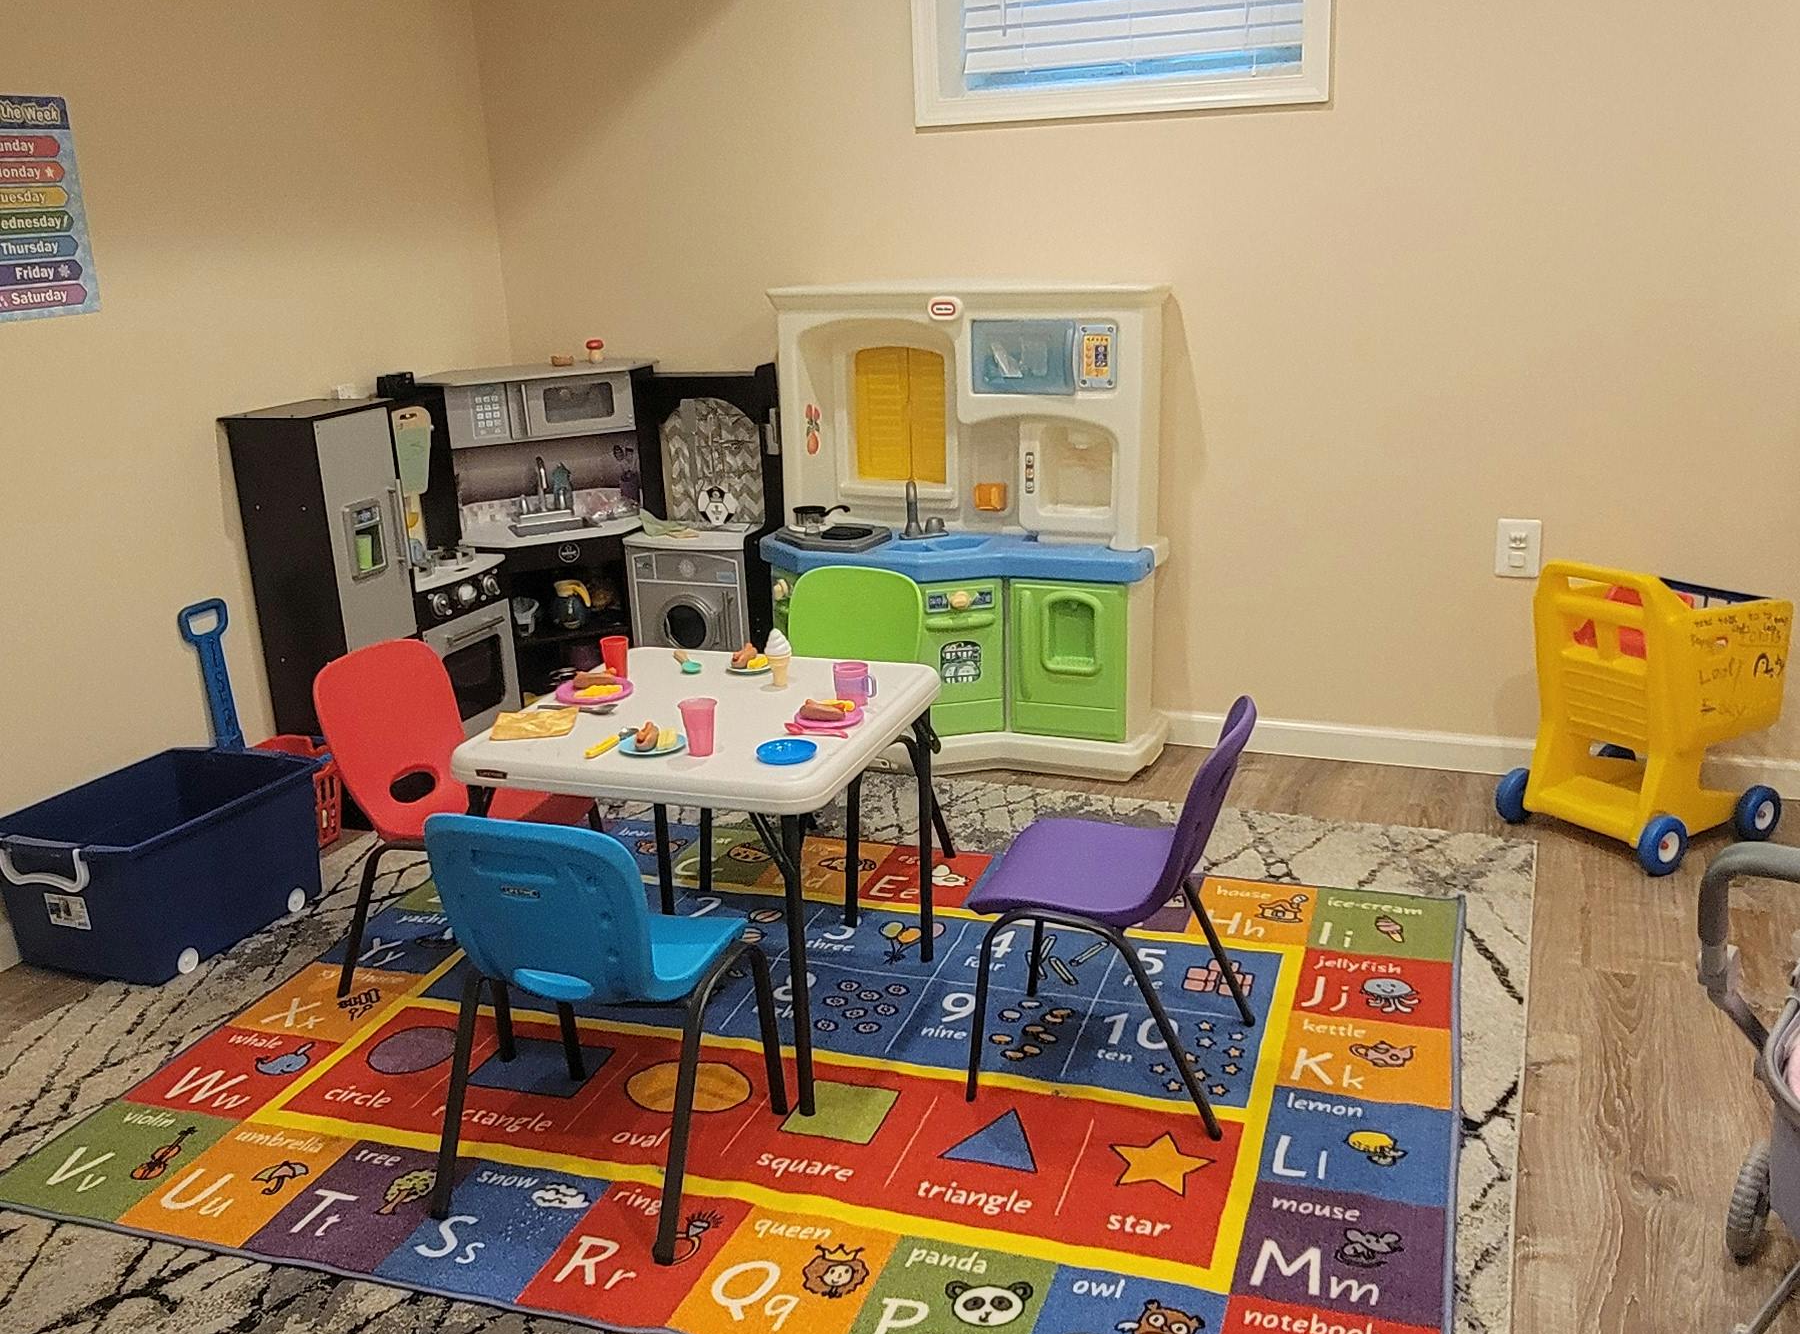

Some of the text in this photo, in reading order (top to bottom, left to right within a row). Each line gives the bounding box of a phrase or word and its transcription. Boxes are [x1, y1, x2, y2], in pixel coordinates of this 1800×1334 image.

[23, 103, 58, 121] Week
[0, 166, 40, 180] onday
[0, 190, 46, 204] uesday
[0, 215, 61, 229] ednesday
[1, 241, 58, 255] Thursday
[15, 265, 54, 280] Friday
[11, 289, 67, 305] Saturday
[869, 875, 919, 899] Ee
[1216, 885, 1272, 901] house
[1327, 896, 1424, 917] ice-cream
[396, 913, 449, 925] yacht
[805, 938, 856, 952] three
[976, 930, 1016, 958] 4
[1136, 948, 1168, 975] 5
[1313, 955, 1402, 975] jellyfish
[1301, 975, 1350, 1012] Jj
[259, 997, 325, 1030] Xx
[941, 991, 977, 1023] 9
[920, 1023, 968, 1041] nine
[1103, 1012, 1179, 1051] 10
[1302, 1018, 1367, 1039] kettle
[228, 1033, 284, 1049] whale
[1096, 1048, 1134, 1063] ten
[1289, 1047, 1366, 1090] Kk
[164, 1067, 250, 1111] Ww
[324, 1085, 393, 1109] circle
[1286, 1091, 1364, 1118] lemon
[121, 1110, 177, 1128] violin
[431, 1105, 553, 1134] rctangle
[234, 1128, 324, 1154] umbrella
[611, 1127, 672, 1149] oval
[45, 1146, 116, 1193] Vv
[354, 1148, 402, 1167] tree
[756, 1151, 856, 1183] square
[476, 1169, 540, 1189] snow
[160, 1168, 235, 1218] Uu
[612, 1188, 663, 1216] ring
[917, 1178, 1034, 1216] triangle
[289, 1188, 359, 1237] Tt
[1271, 1196, 1361, 1222] mouse
[753, 1217, 833, 1241] queen
[1106, 1213, 1173, 1238] star
[414, 1215, 486, 1265] Ss
[552, 1234, 637, 1291] Rr
[904, 1247, 989, 1274] panda
[1249, 1238, 1381, 1307] Mm
[710, 1260, 800, 1333] Qq
[1072, 1278, 1127, 1300] owl
